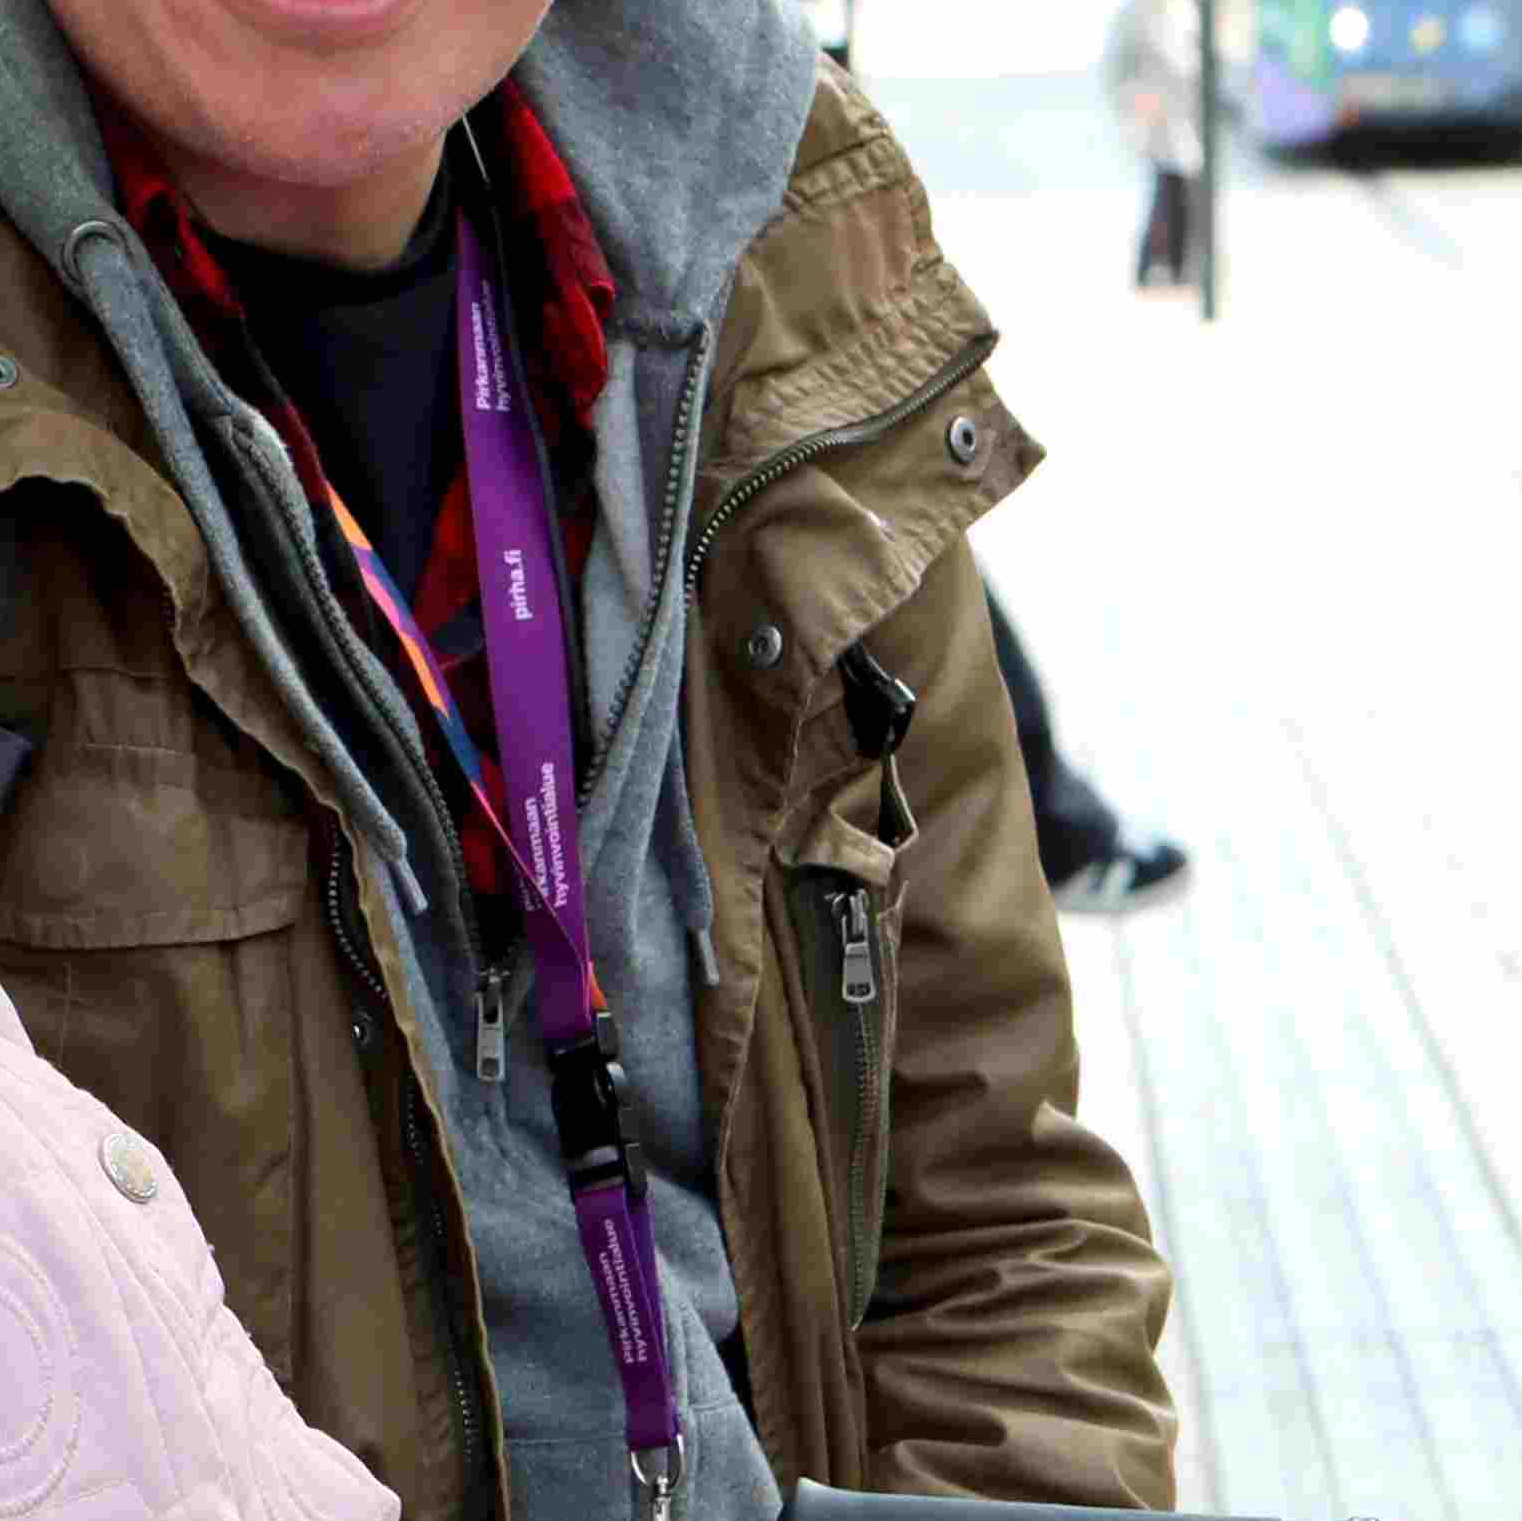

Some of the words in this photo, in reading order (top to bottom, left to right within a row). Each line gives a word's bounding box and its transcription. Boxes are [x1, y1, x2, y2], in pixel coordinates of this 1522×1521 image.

[471, 302, 491, 410] Pirkanmaan
[503, 548, 534, 621] pirha.fi
[524, 796, 550, 898] irkanmaan
[541, 762, 569, 908] hyvinvointialue
[598, 1250, 635, 1365] Pirkanmaan
[603, 1217, 648, 1363] hyvinvointialue
